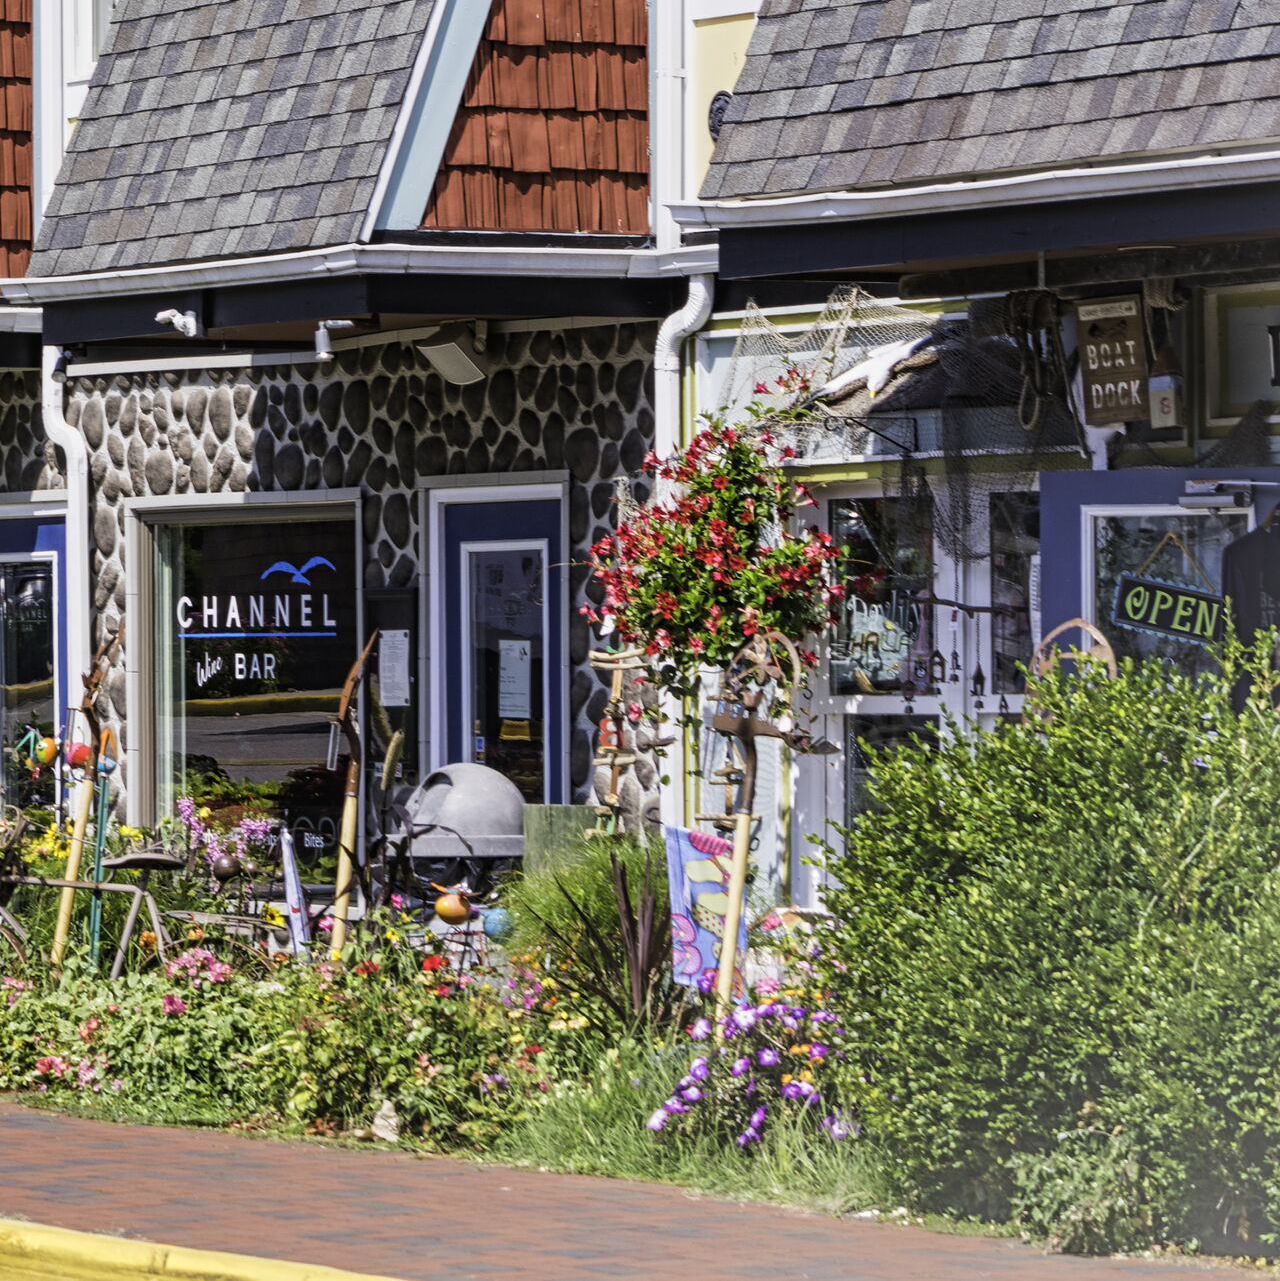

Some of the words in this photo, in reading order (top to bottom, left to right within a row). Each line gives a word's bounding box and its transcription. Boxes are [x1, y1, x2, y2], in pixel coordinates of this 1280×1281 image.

[1086, 340, 1136, 369] BOAT
[1091, 380, 1142, 409] DOCK
[176, 594, 337, 629] CHANNEL
[1125, 586, 1220, 640] OPEN
[196, 651, 224, 687] Wine
[235, 653, 276, 679] BAR
[303, 832, 325, 848] Bites
